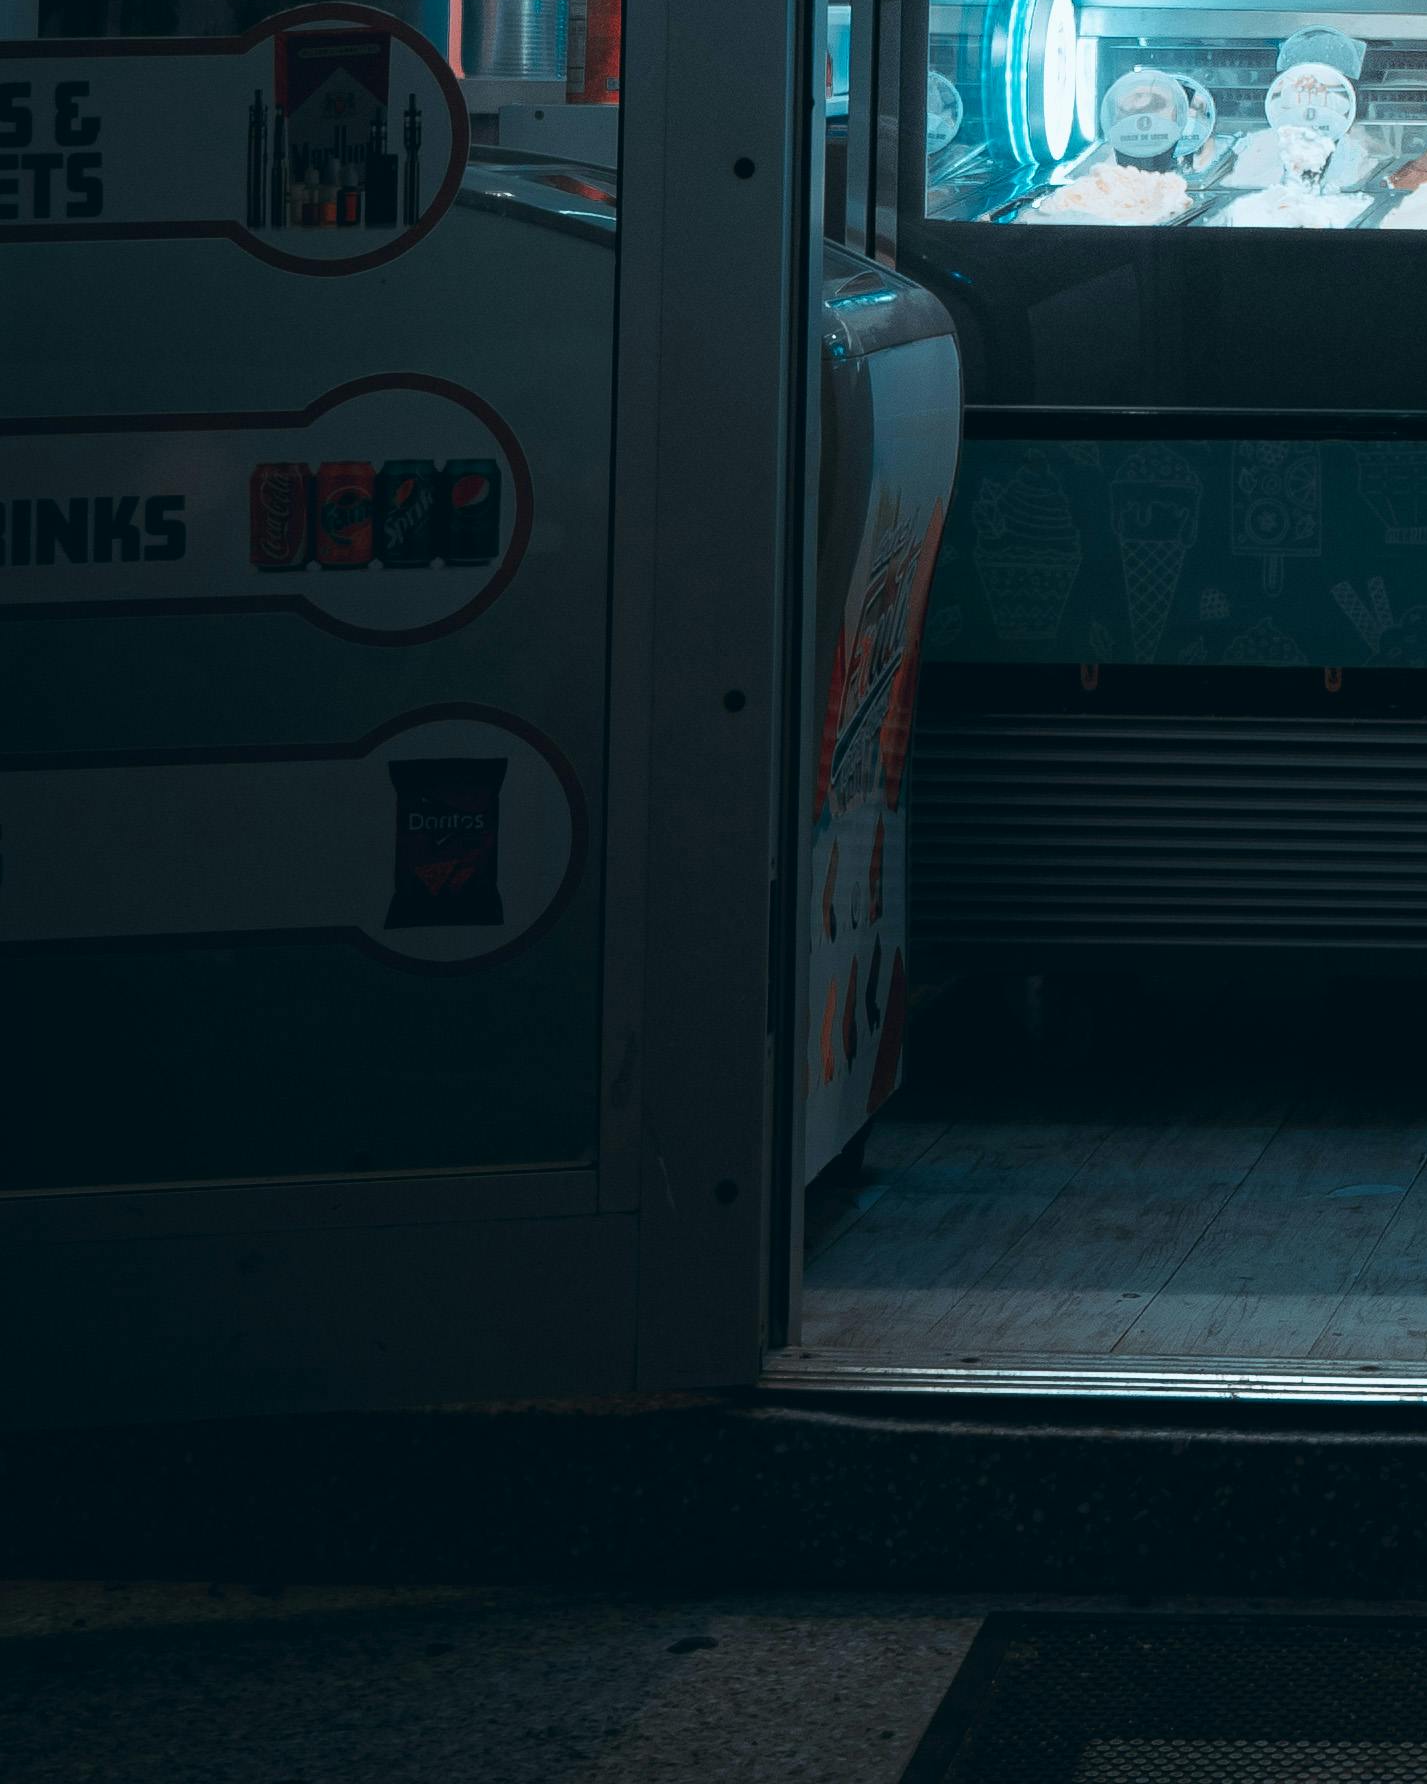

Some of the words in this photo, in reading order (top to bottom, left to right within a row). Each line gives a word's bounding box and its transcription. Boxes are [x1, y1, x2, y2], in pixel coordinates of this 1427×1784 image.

[0, 152, 103, 220] ETS
[0, 494, 188, 567] INKS
[408, 812, 485, 831] Doritos
